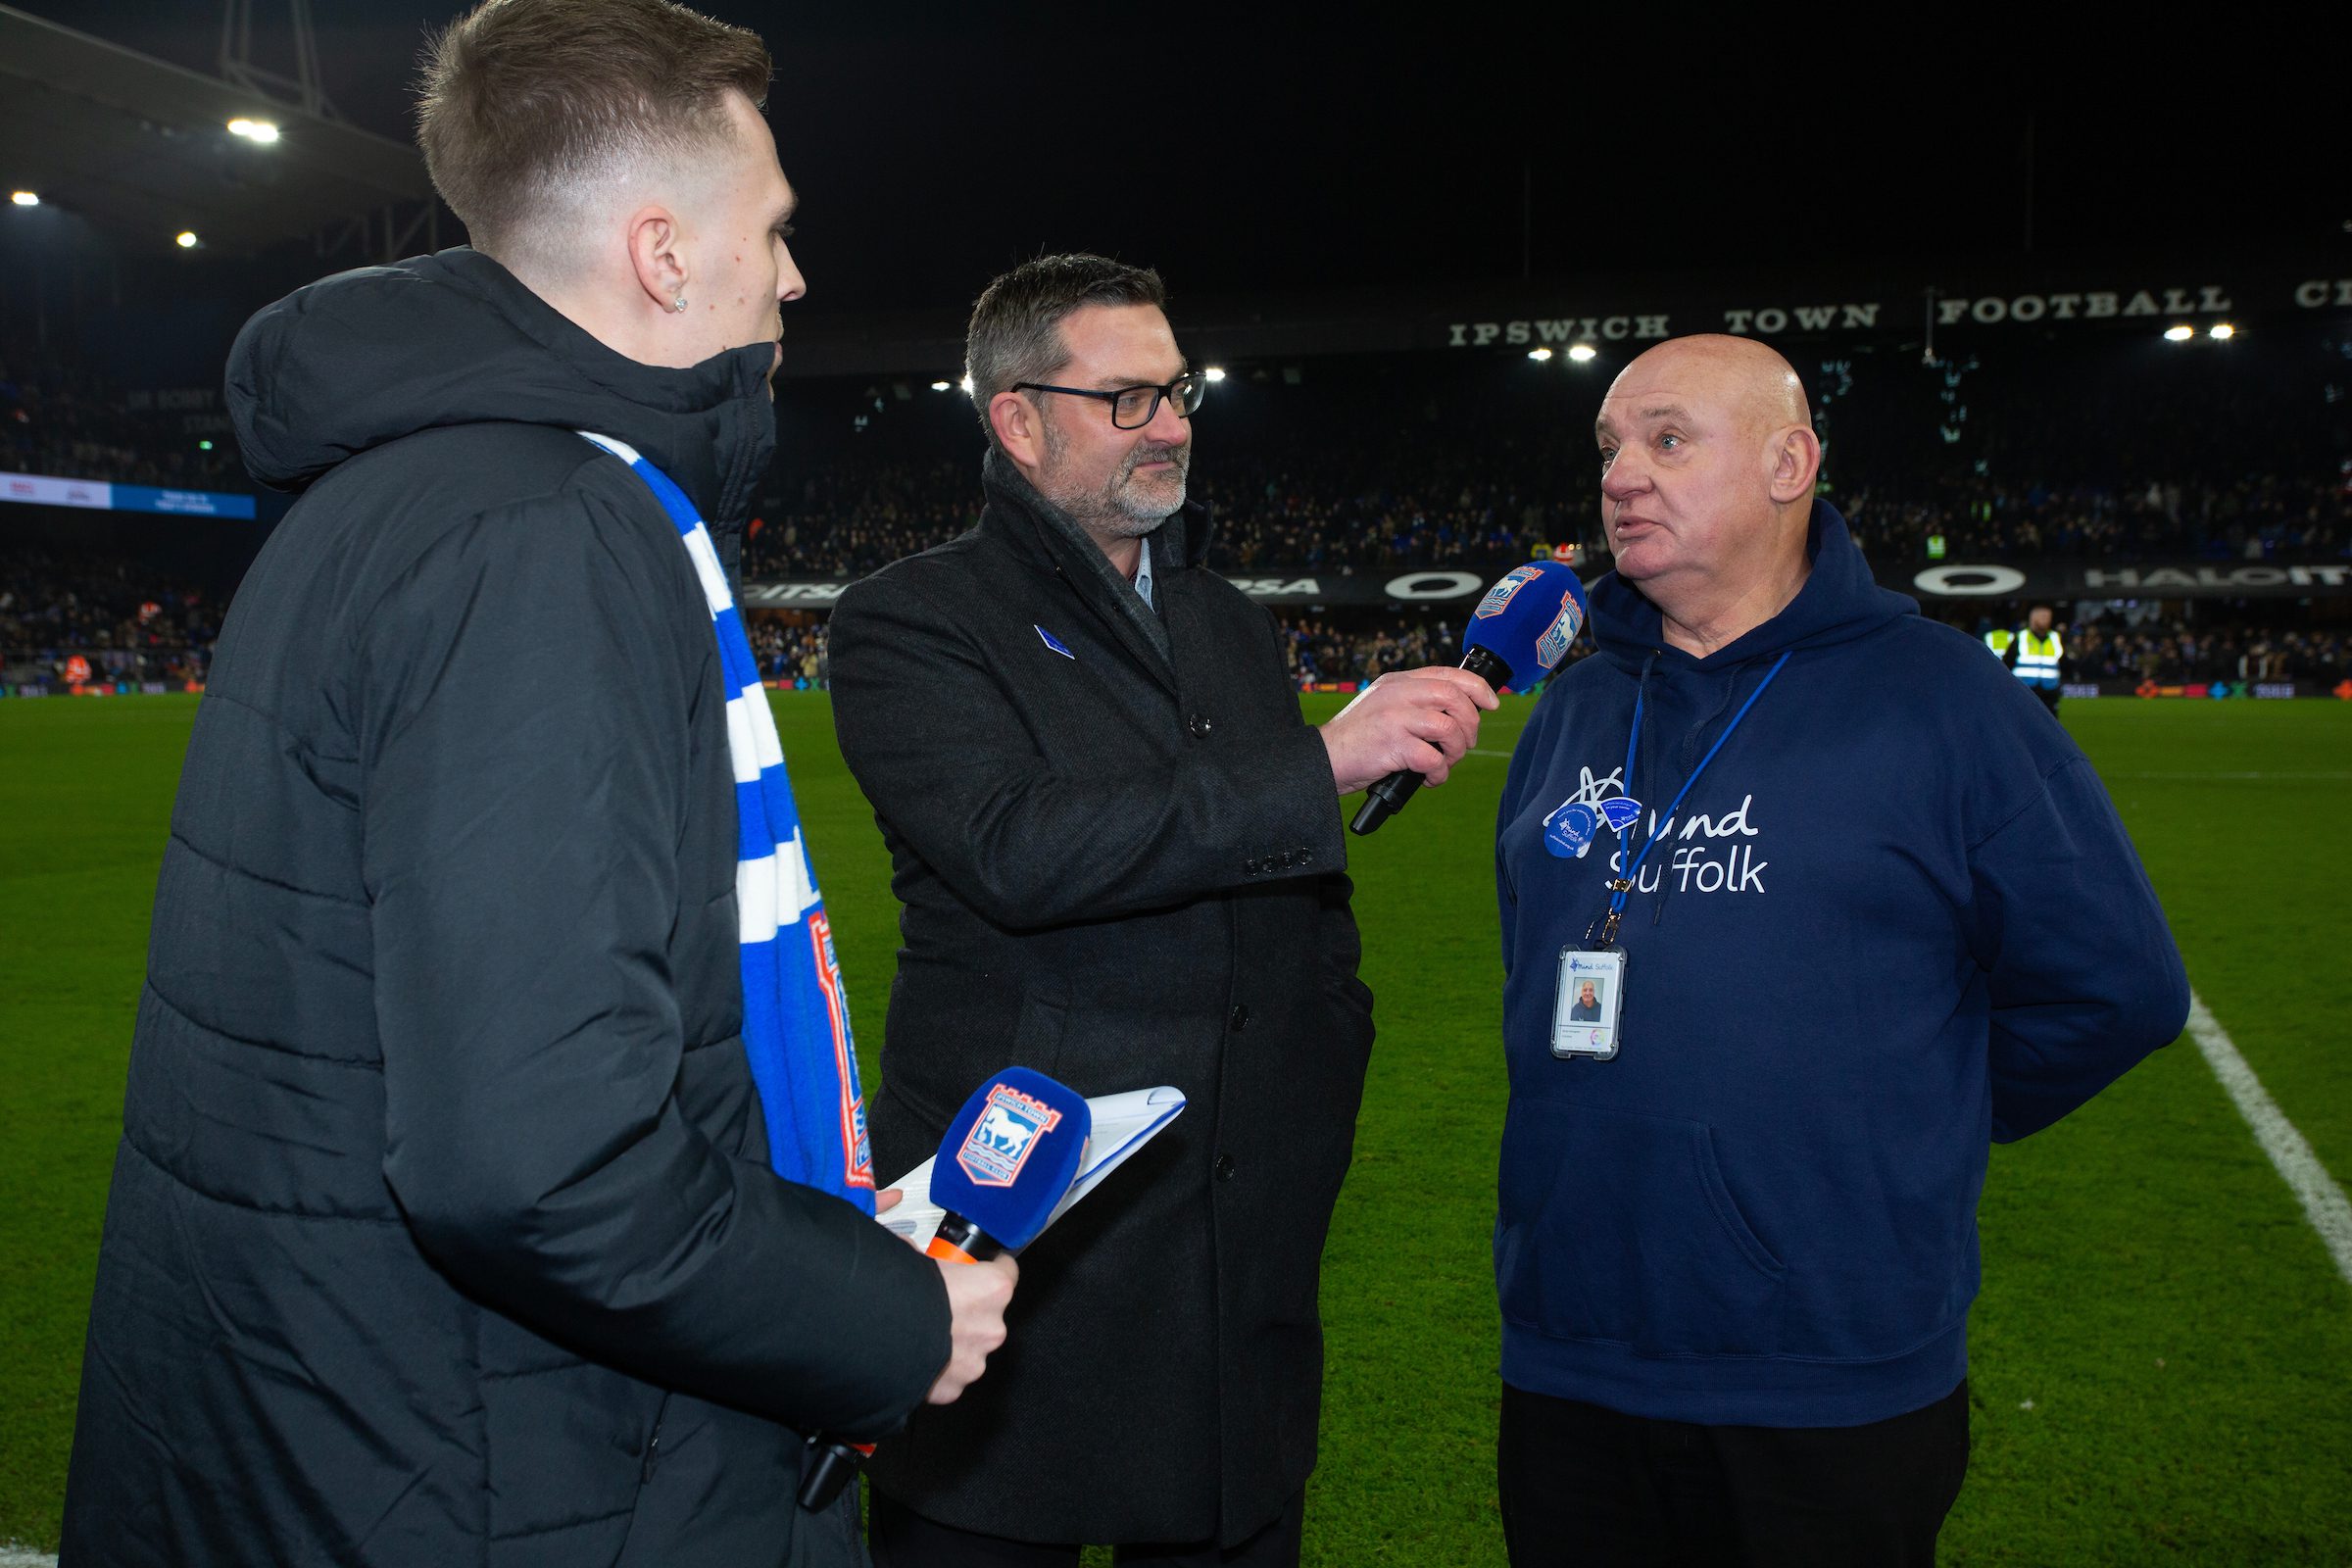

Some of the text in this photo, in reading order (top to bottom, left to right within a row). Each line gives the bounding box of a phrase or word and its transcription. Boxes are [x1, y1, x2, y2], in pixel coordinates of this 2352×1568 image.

[1449, 315, 1670, 347] IPSWICH
[1724, 303, 1881, 334] TOWN
[1937, 286, 2233, 324] FOOTBALL
[1024, 1103, 1049, 1124] TOWN
